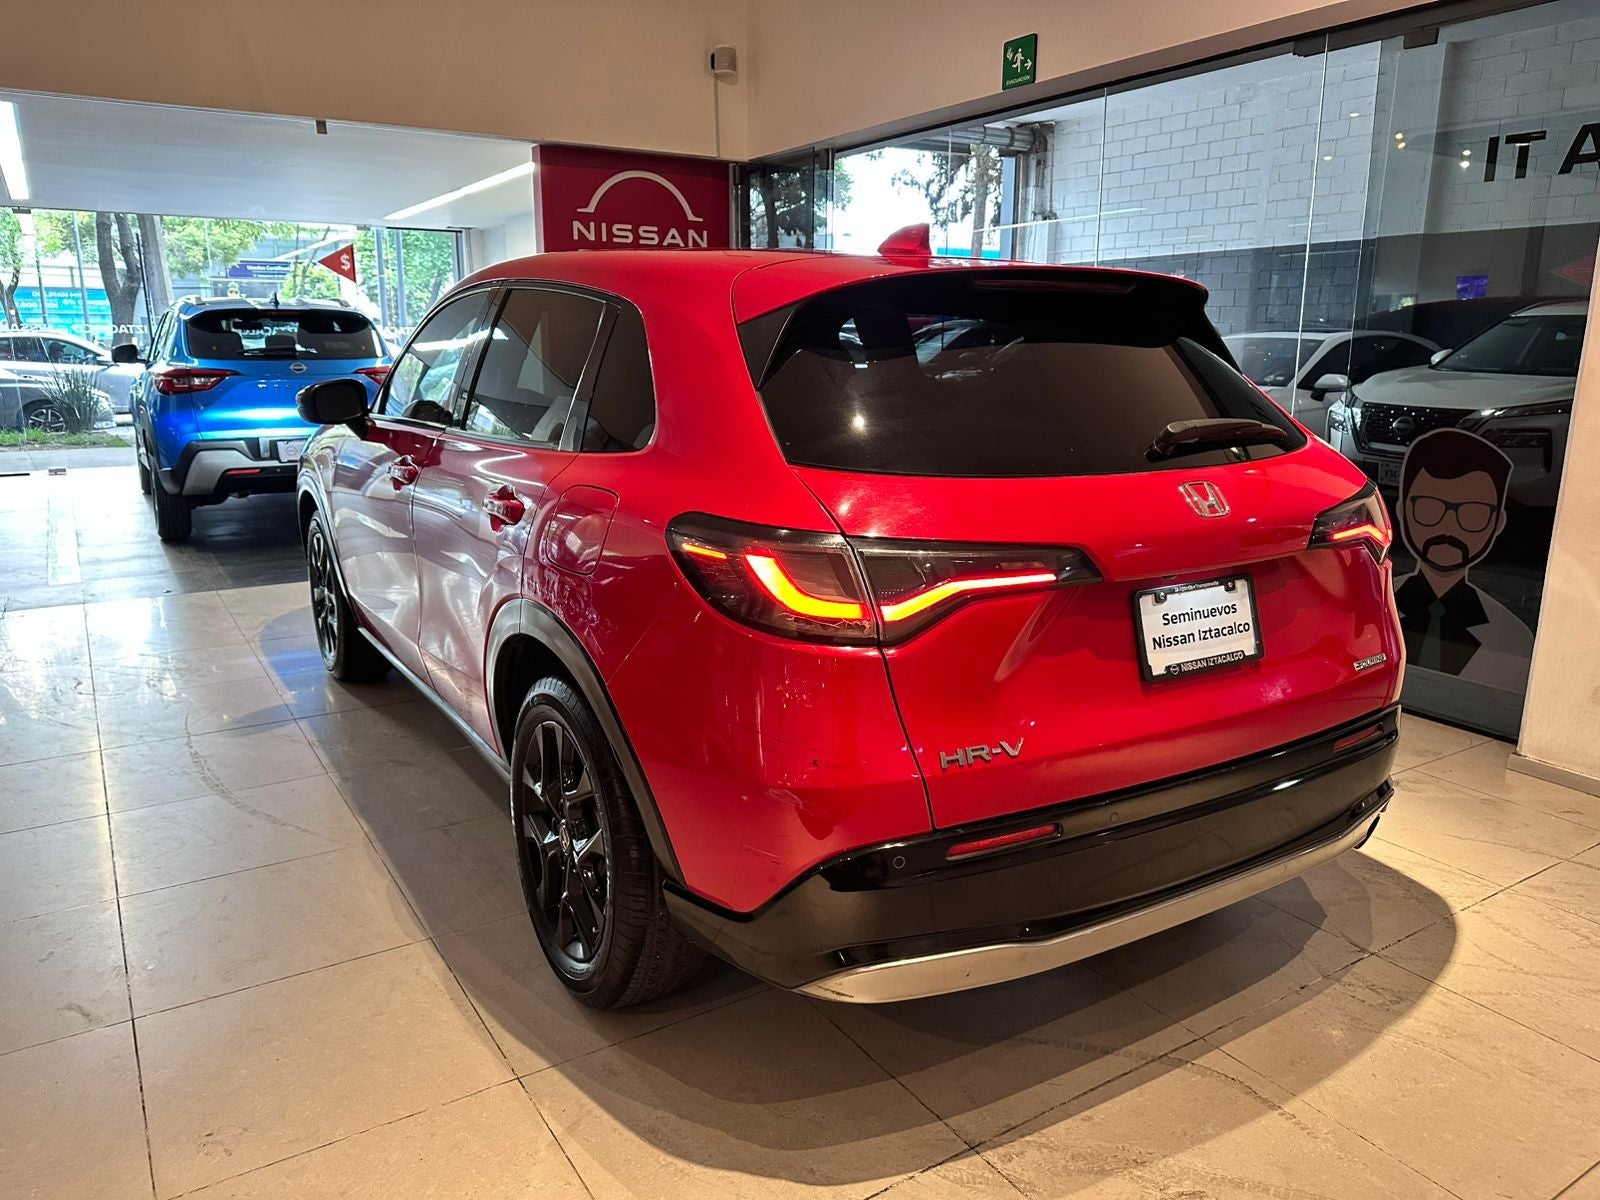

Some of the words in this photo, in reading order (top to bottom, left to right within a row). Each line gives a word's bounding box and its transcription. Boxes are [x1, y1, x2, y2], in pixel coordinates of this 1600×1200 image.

[572, 220, 708, 248] NISSAN
[1162, 603, 1237, 626] Seminuevos
[1152, 633, 1196, 650] Nissan
[1198, 622, 1251, 642] Iztacalco
[1181, 659, 1207, 672] NISSAN
[1208, 651, 1244, 666] IZTACALCO
[940, 737, 1024, 770] HR-V
